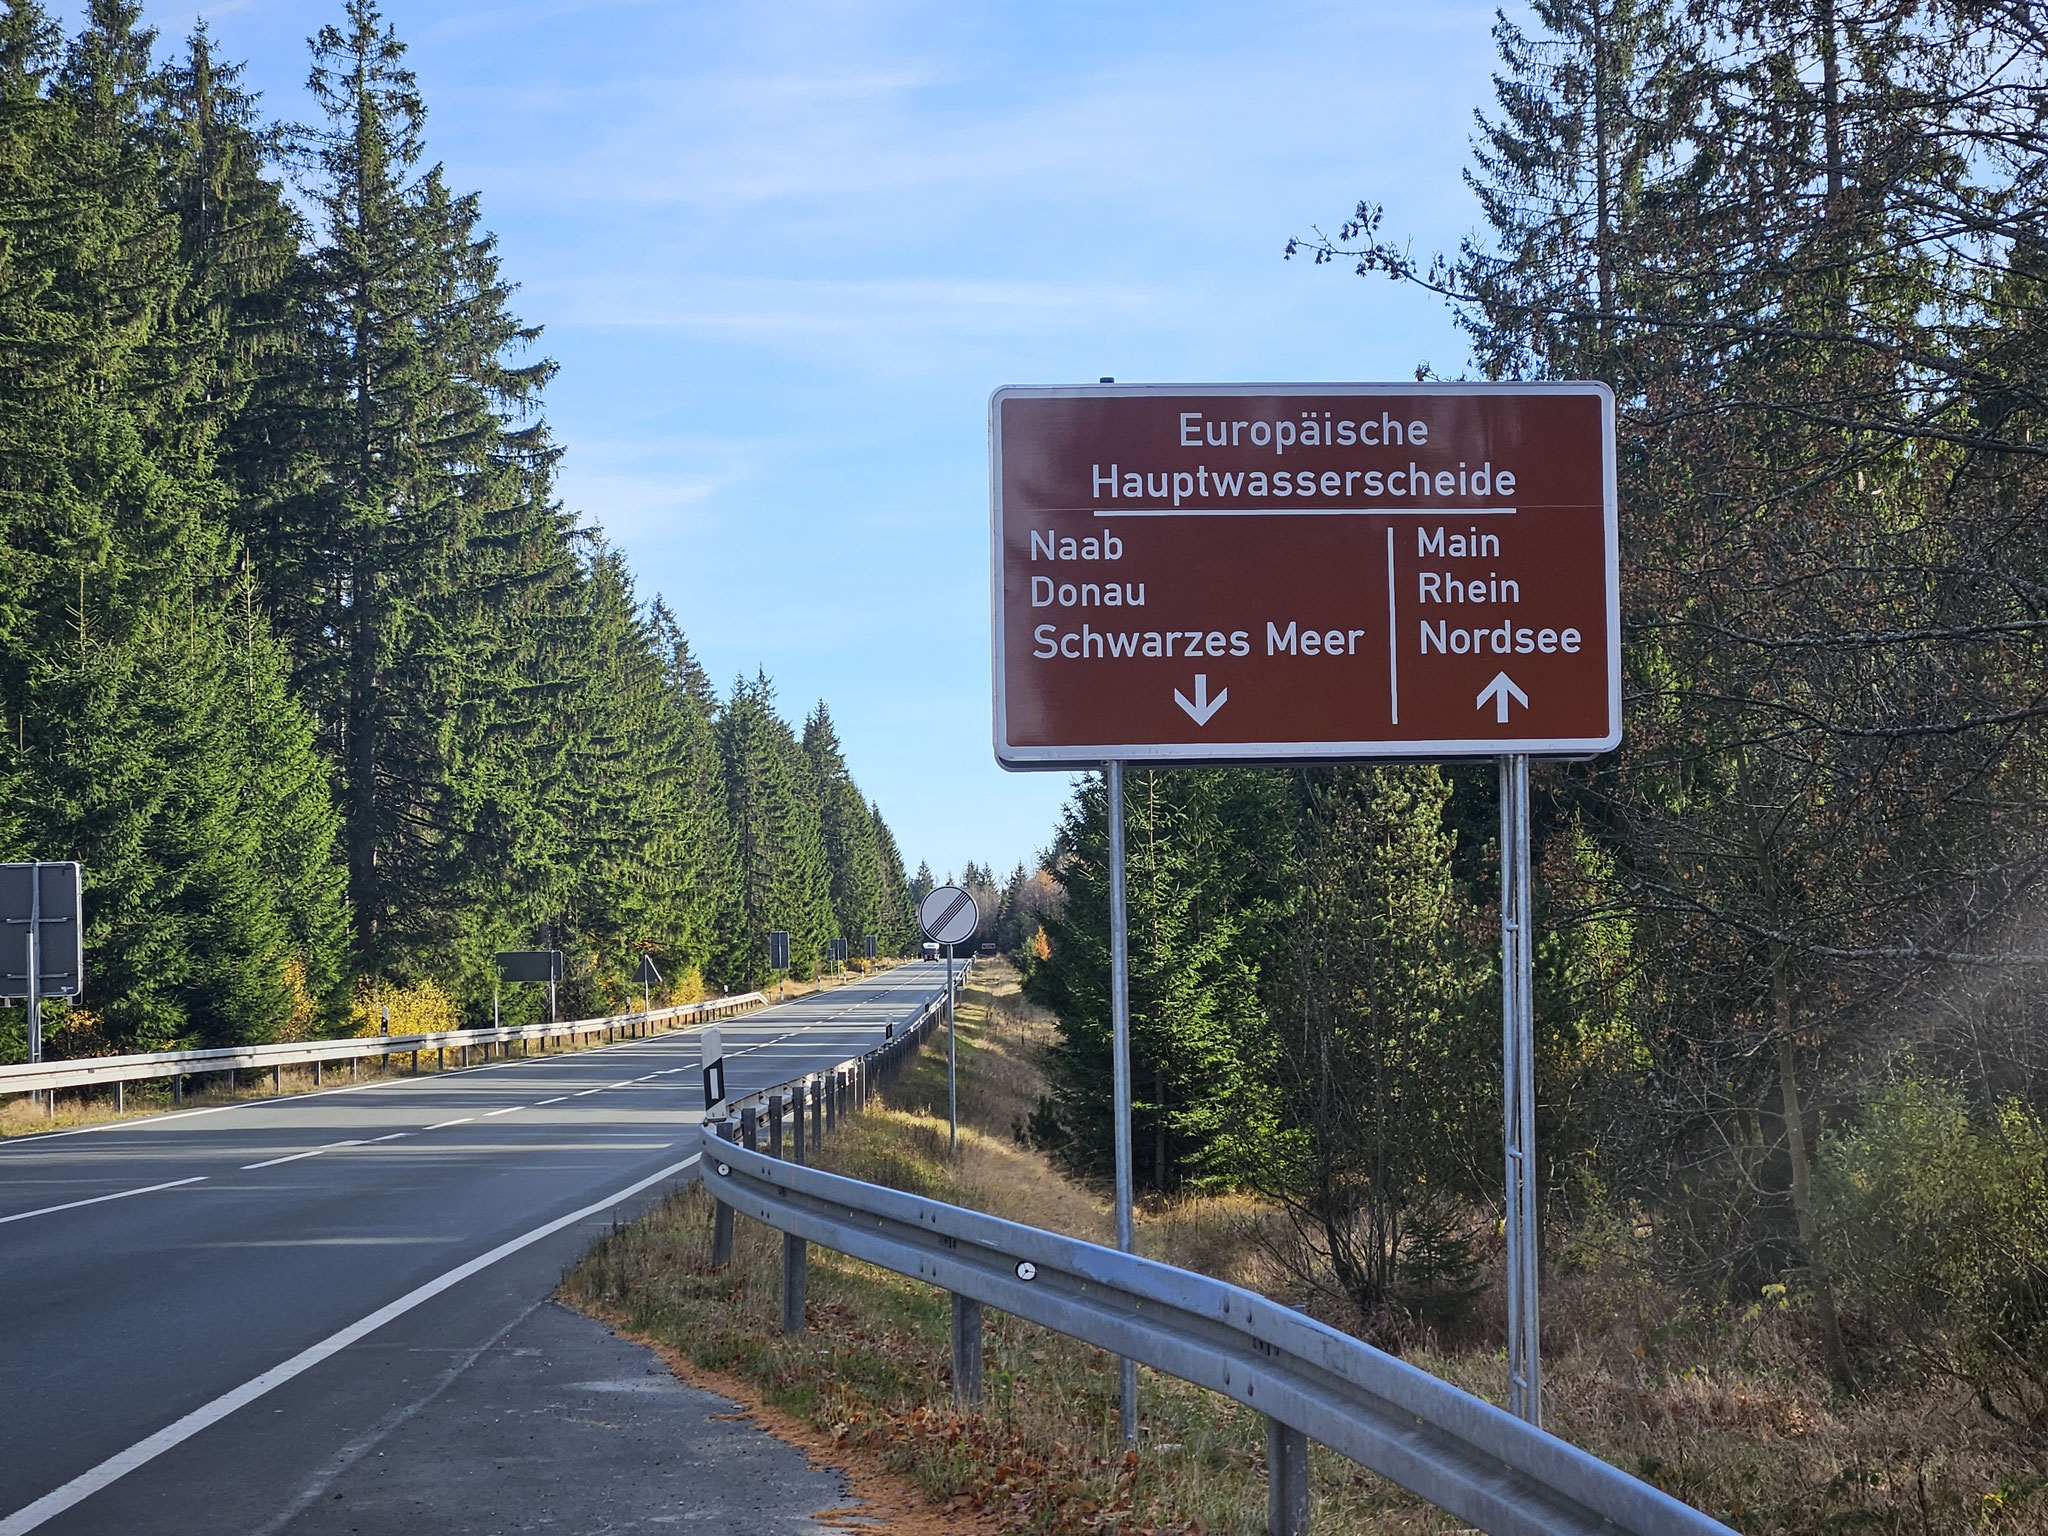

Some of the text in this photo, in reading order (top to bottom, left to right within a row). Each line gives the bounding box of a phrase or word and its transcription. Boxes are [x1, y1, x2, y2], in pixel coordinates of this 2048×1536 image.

[1180, 412, 1428, 454] Europäische
[1092, 462, 1516, 506] Hauptwasserscheide
[1030, 529, 1123, 561] Naab
[1417, 527, 1500, 558] Main
[1031, 577, 1145, 607] Donau
[1419, 572, 1520, 604] Rhein
[1032, 621, 1365, 659] Schwarzes Meer
[1420, 619, 1582, 655] Nordsee
